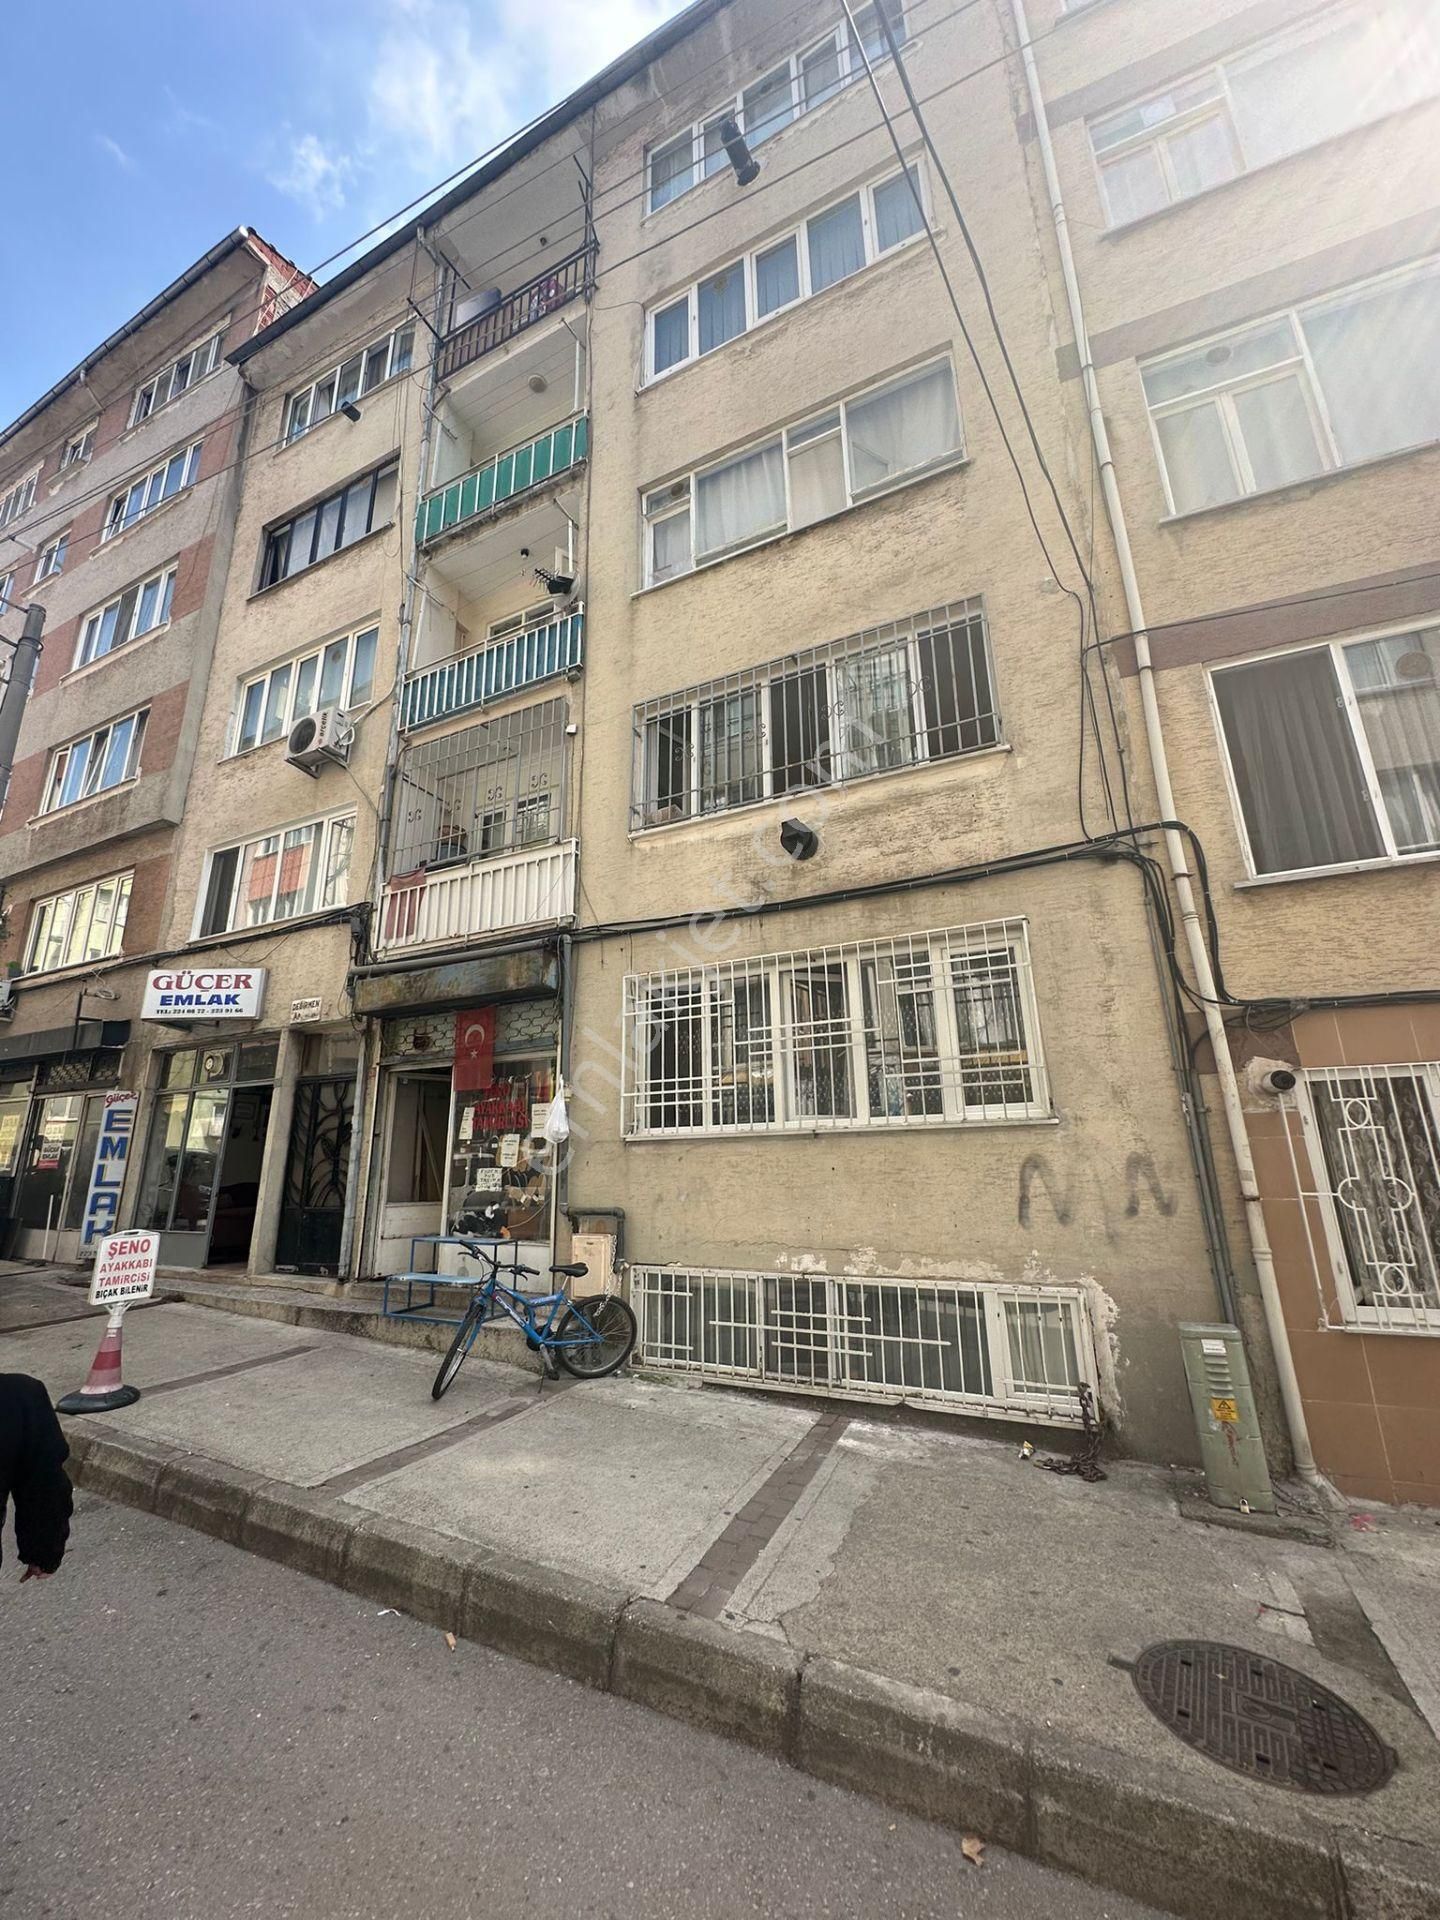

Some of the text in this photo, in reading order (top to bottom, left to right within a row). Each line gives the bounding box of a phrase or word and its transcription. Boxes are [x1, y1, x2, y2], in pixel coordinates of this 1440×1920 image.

[152, 970, 253, 992] GÜÇER
[159, 994, 240, 1006] EMLAK
[84, 1109, 133, 1245] EMLAK
[108, 1239, 151, 1260] ŞENO
